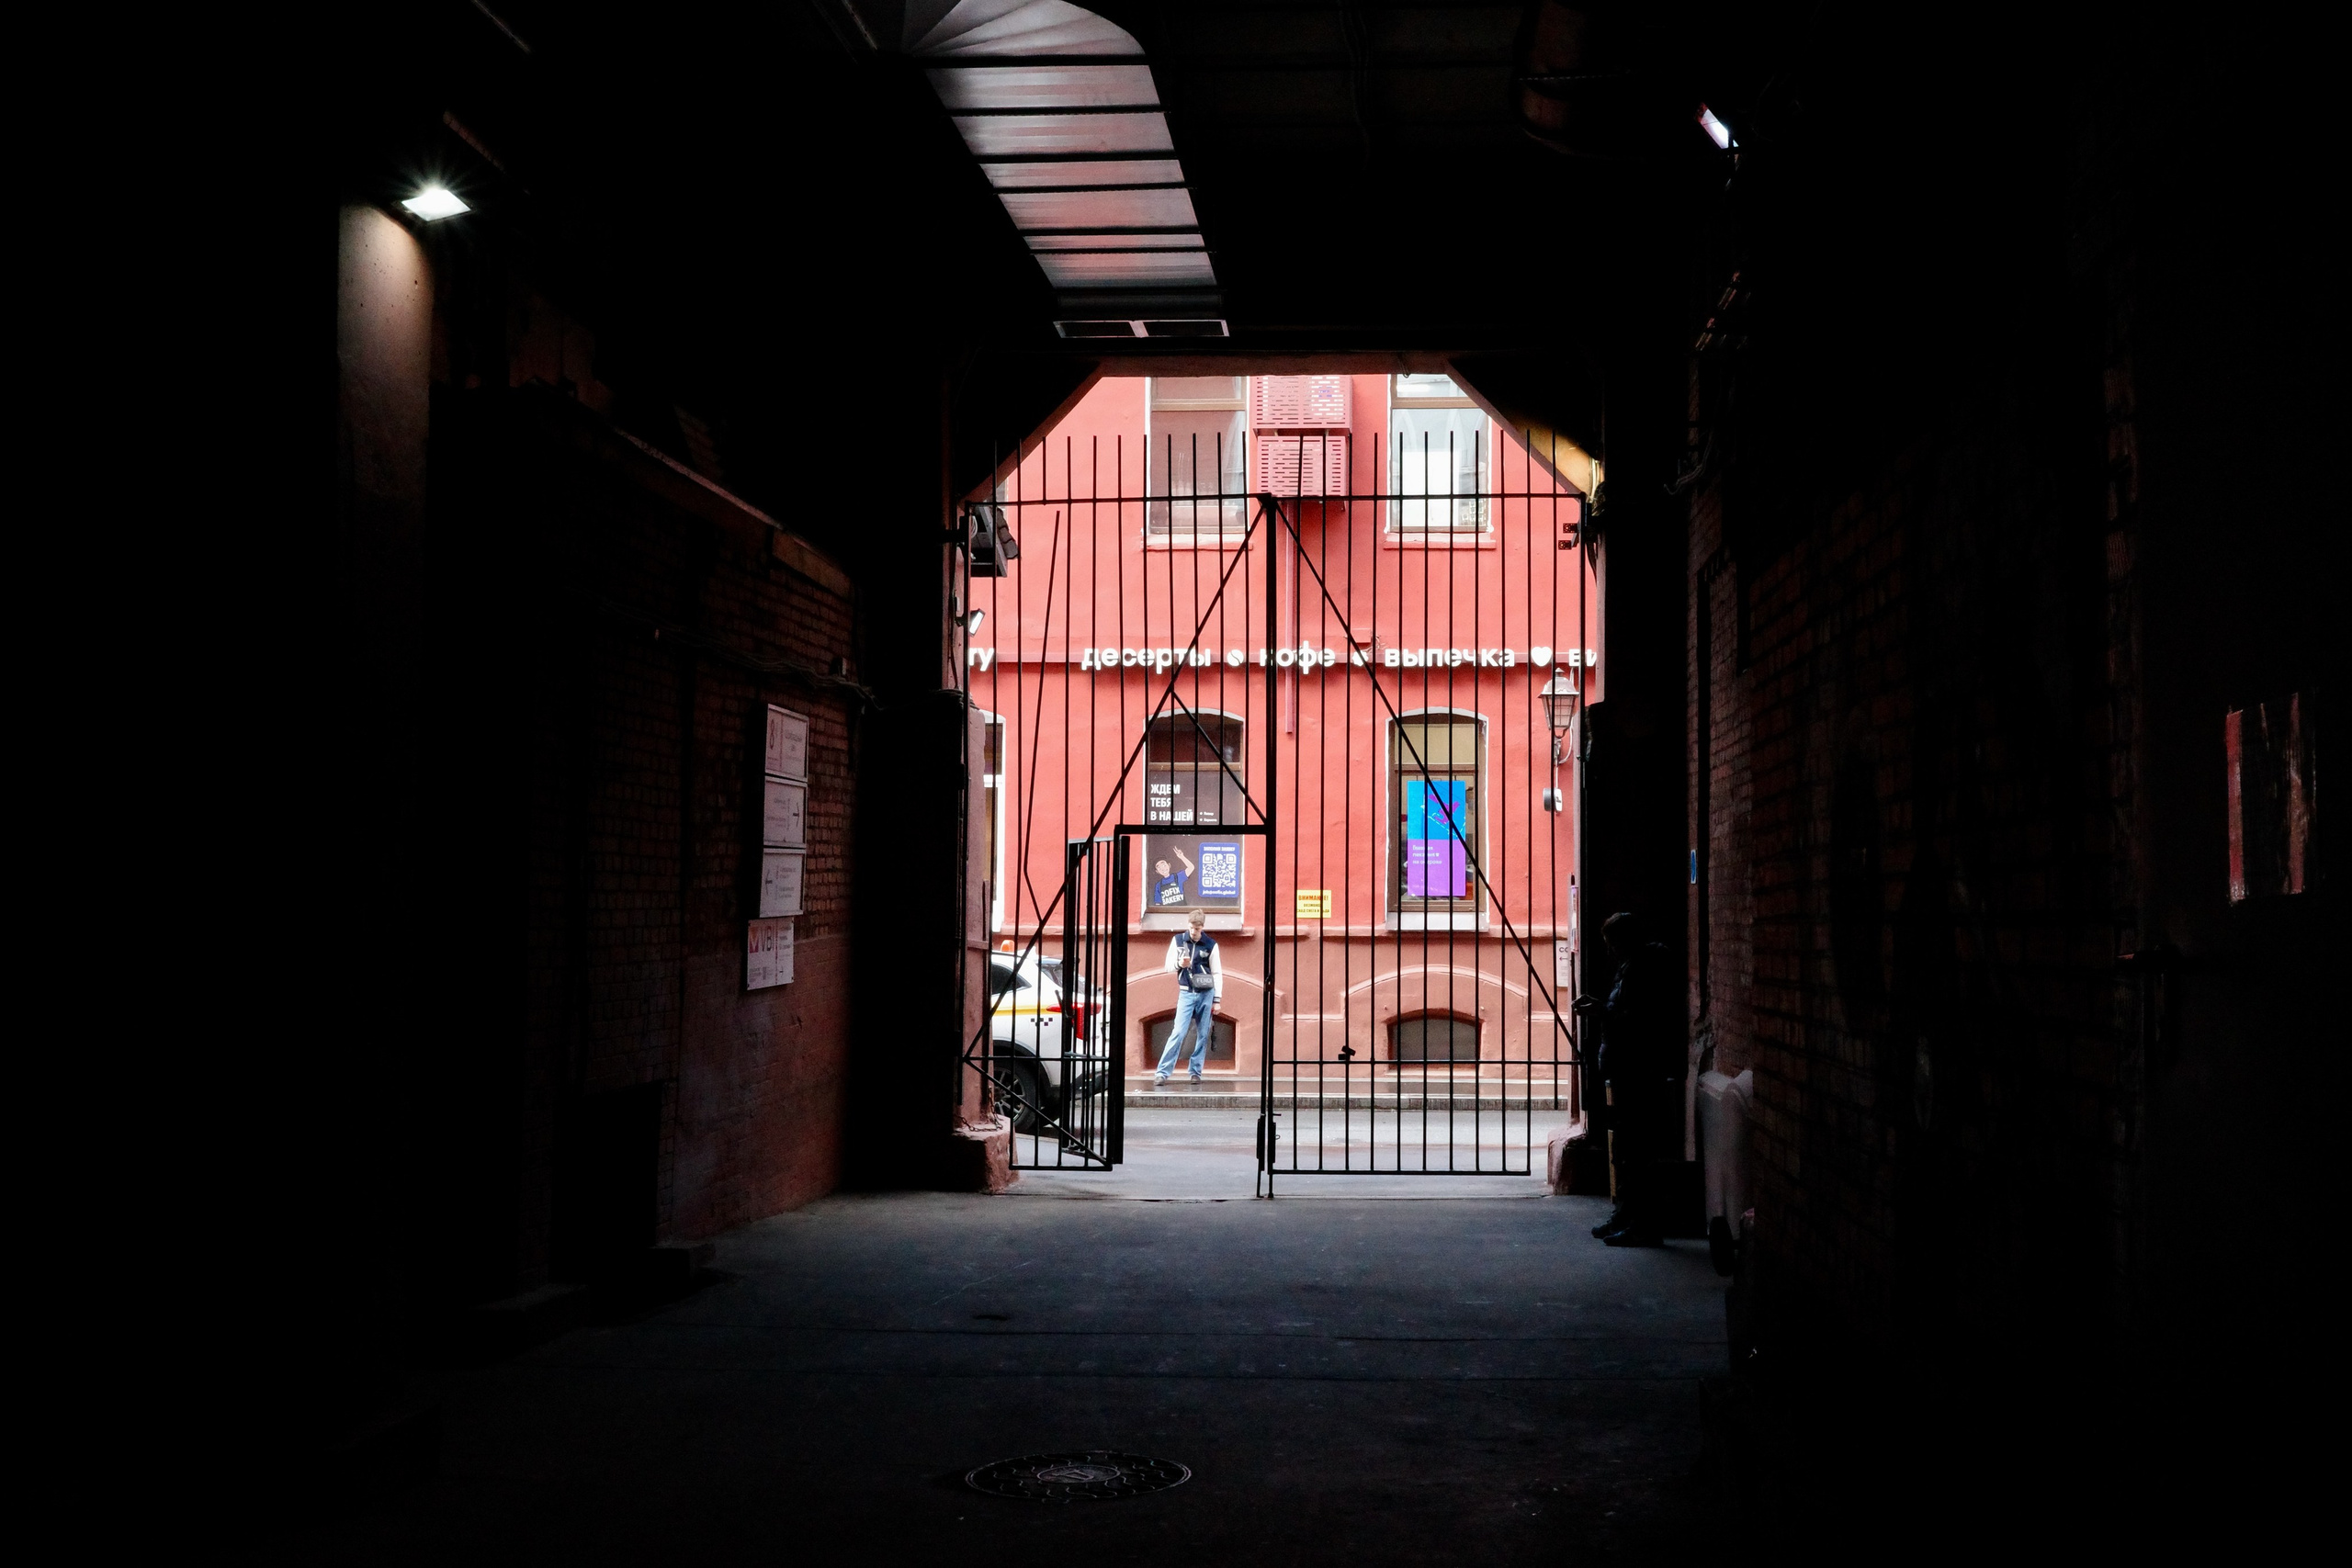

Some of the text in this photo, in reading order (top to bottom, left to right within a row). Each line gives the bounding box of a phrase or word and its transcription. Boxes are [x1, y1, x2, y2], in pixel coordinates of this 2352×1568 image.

[1081, 648, 1211, 674] десерты
[1385, 648, 1515, 667] выпечка
[1150, 797, 1171, 807] ТЕБЯ
[1150, 809, 1193, 821] В НАШЕЙ
